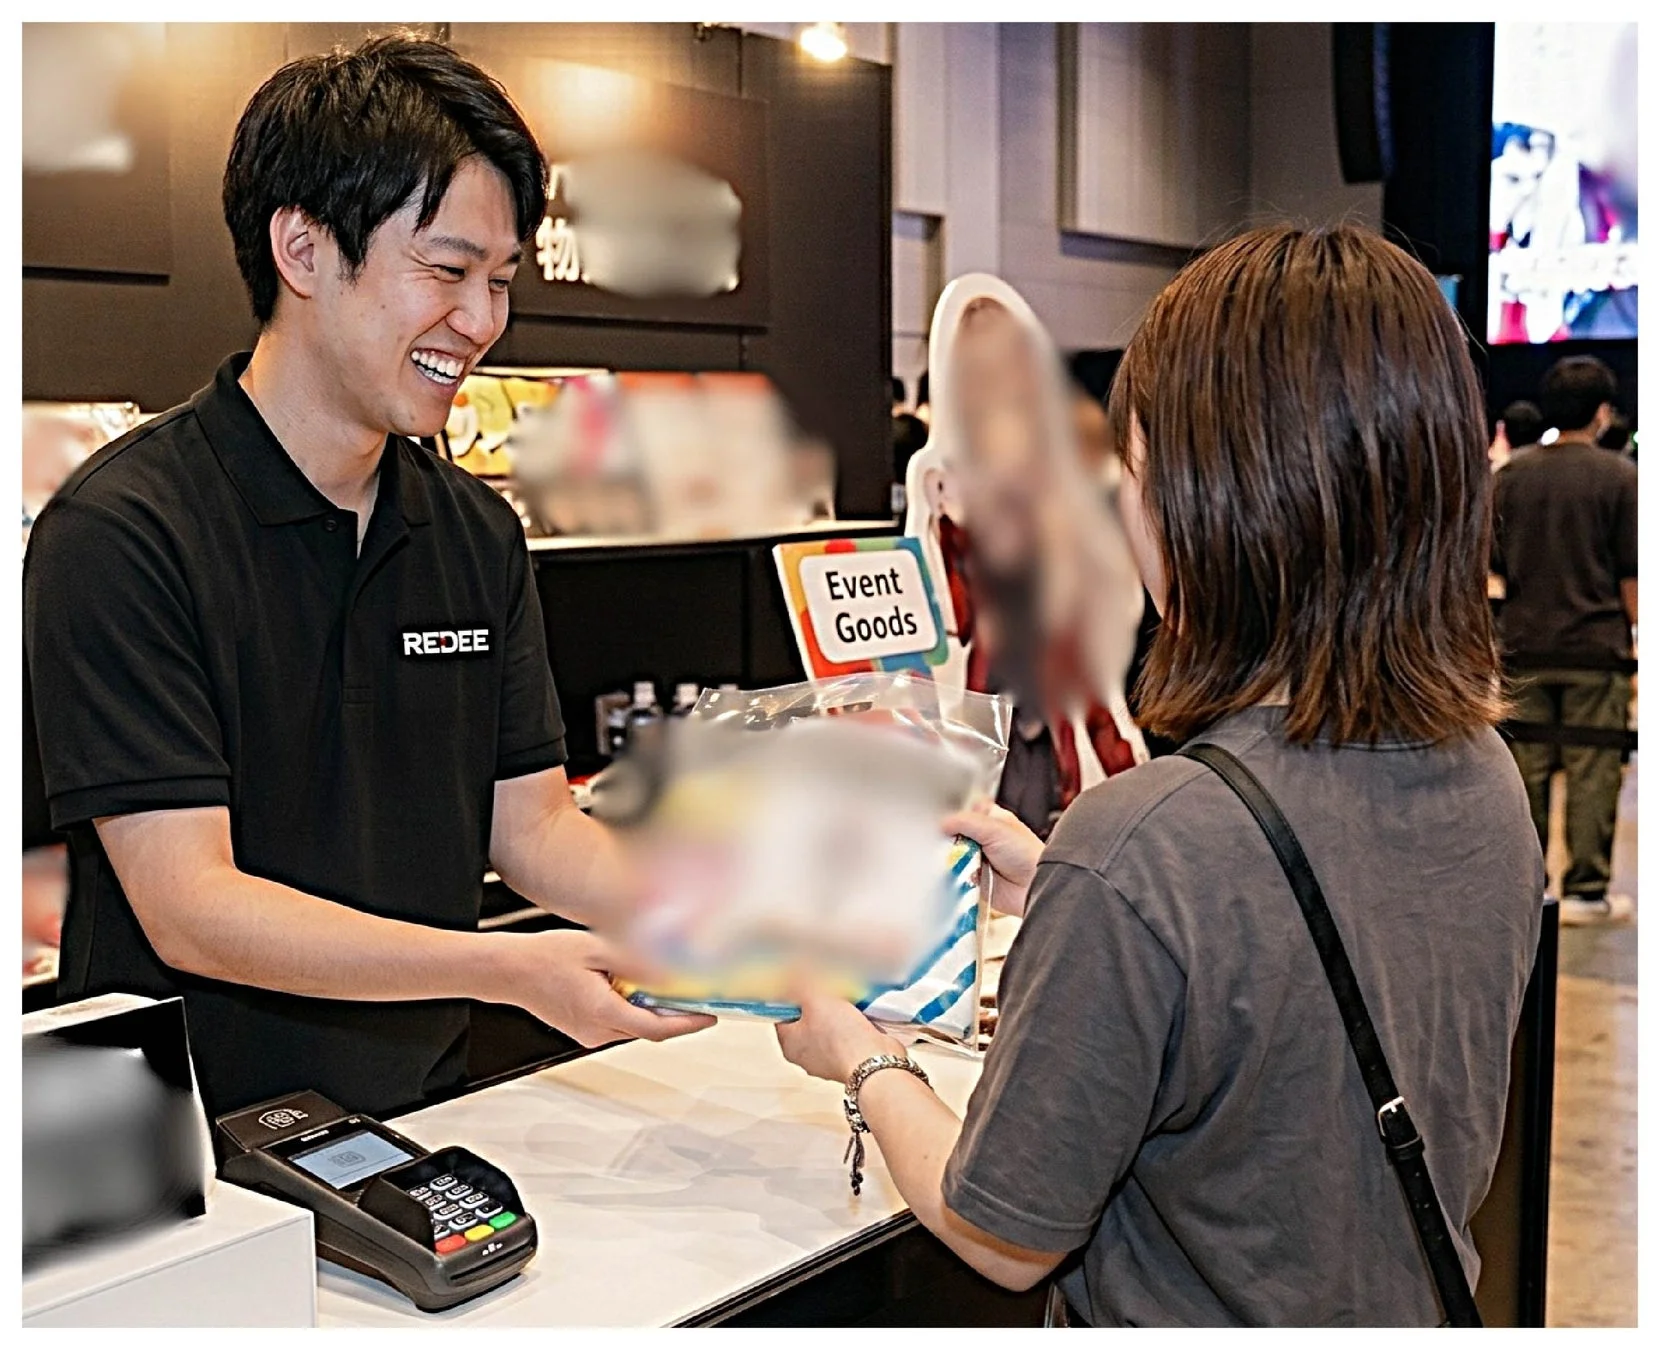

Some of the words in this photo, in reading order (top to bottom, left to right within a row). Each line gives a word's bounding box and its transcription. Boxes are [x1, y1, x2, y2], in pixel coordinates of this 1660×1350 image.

[825, 568, 903, 600] Event
[835, 605, 918, 643] Goods
[402, 629, 489, 655] REDEE
